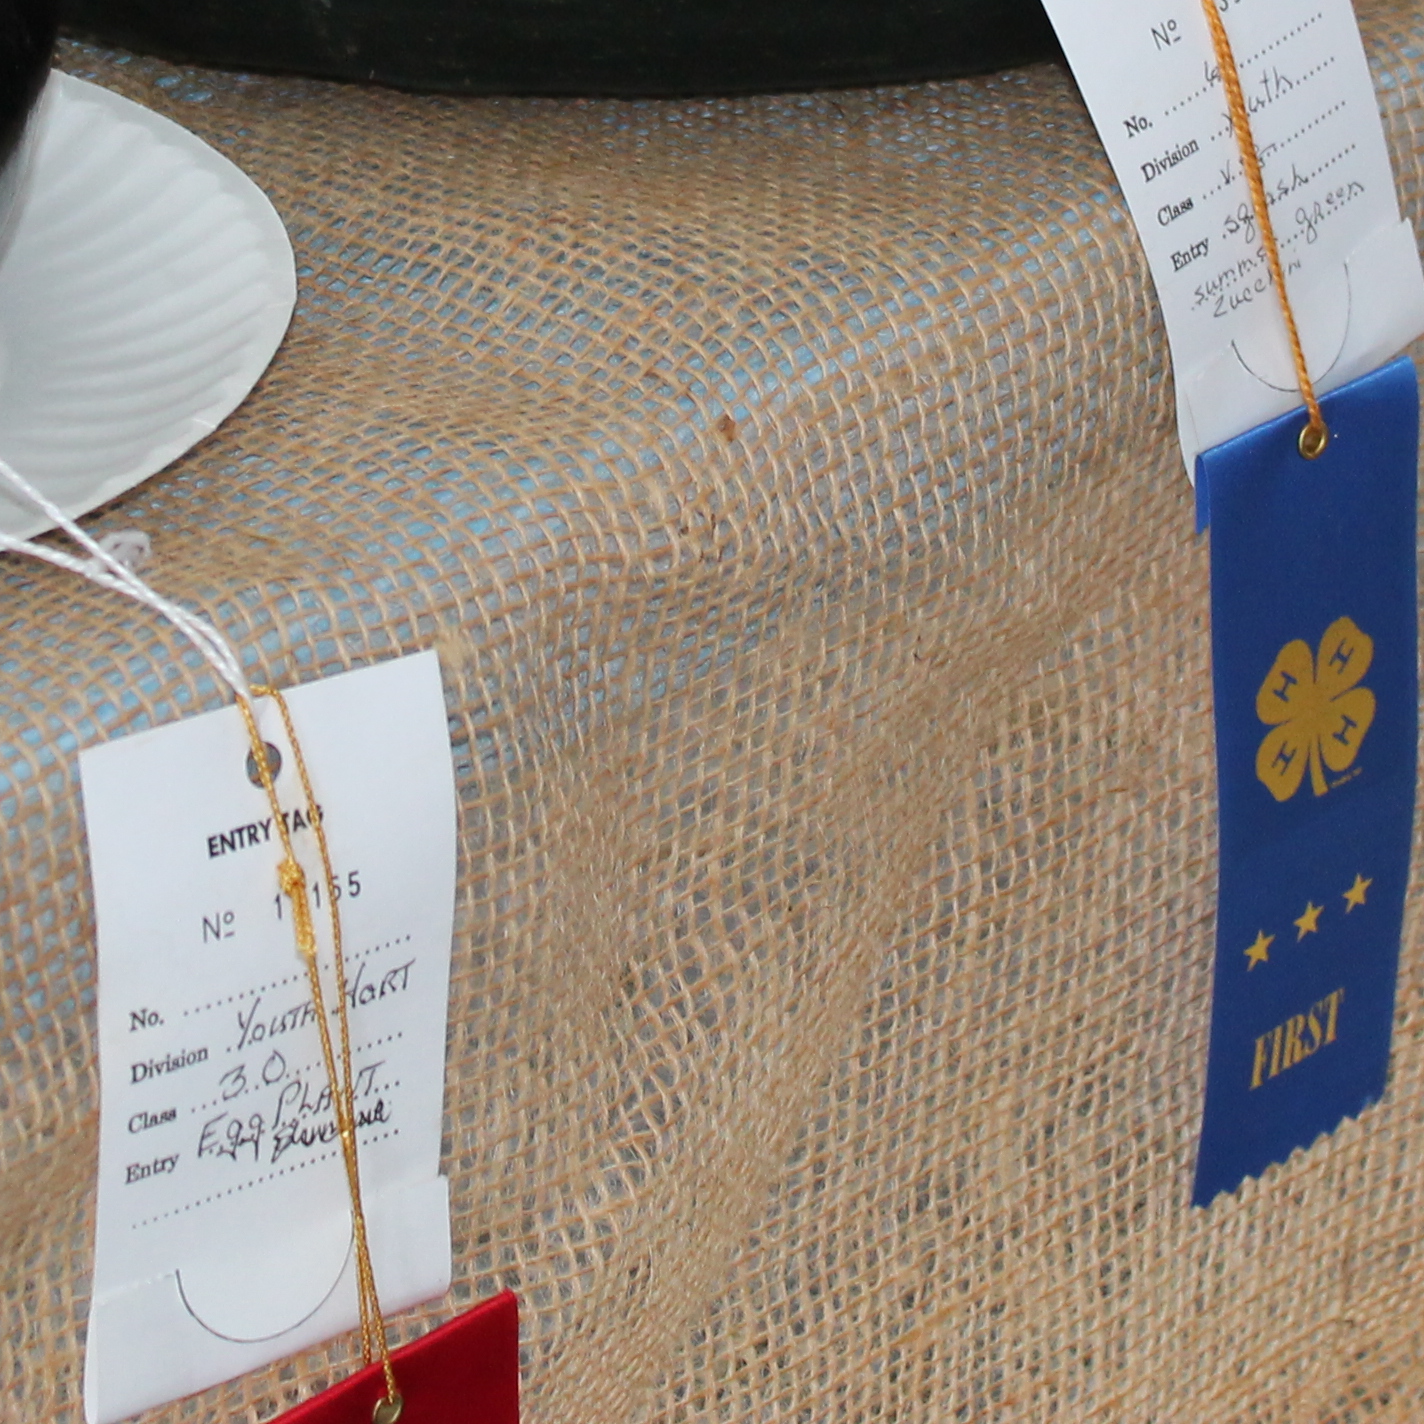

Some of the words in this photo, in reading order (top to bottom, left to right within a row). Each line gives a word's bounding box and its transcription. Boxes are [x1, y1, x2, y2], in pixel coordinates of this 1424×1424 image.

[1123, 115, 1153, 138] No.
[1140, 138, 1200, 184] Division
[1157, 196, 1194, 227] Class
[1170, 237, 1210, 272] Entry
[1224, 163, 1309, 244] sqash
[207, 817, 273, 860] ENTRY
[274, 869, 362, 921] 1155
[128, 1007, 165, 1033] No.
[1249, 986, 1346, 1092] FIRST
[130, 1046, 210, 1085] Division
[127, 1106, 178, 1135] Class
[125, 1153, 180, 1186] Entry
